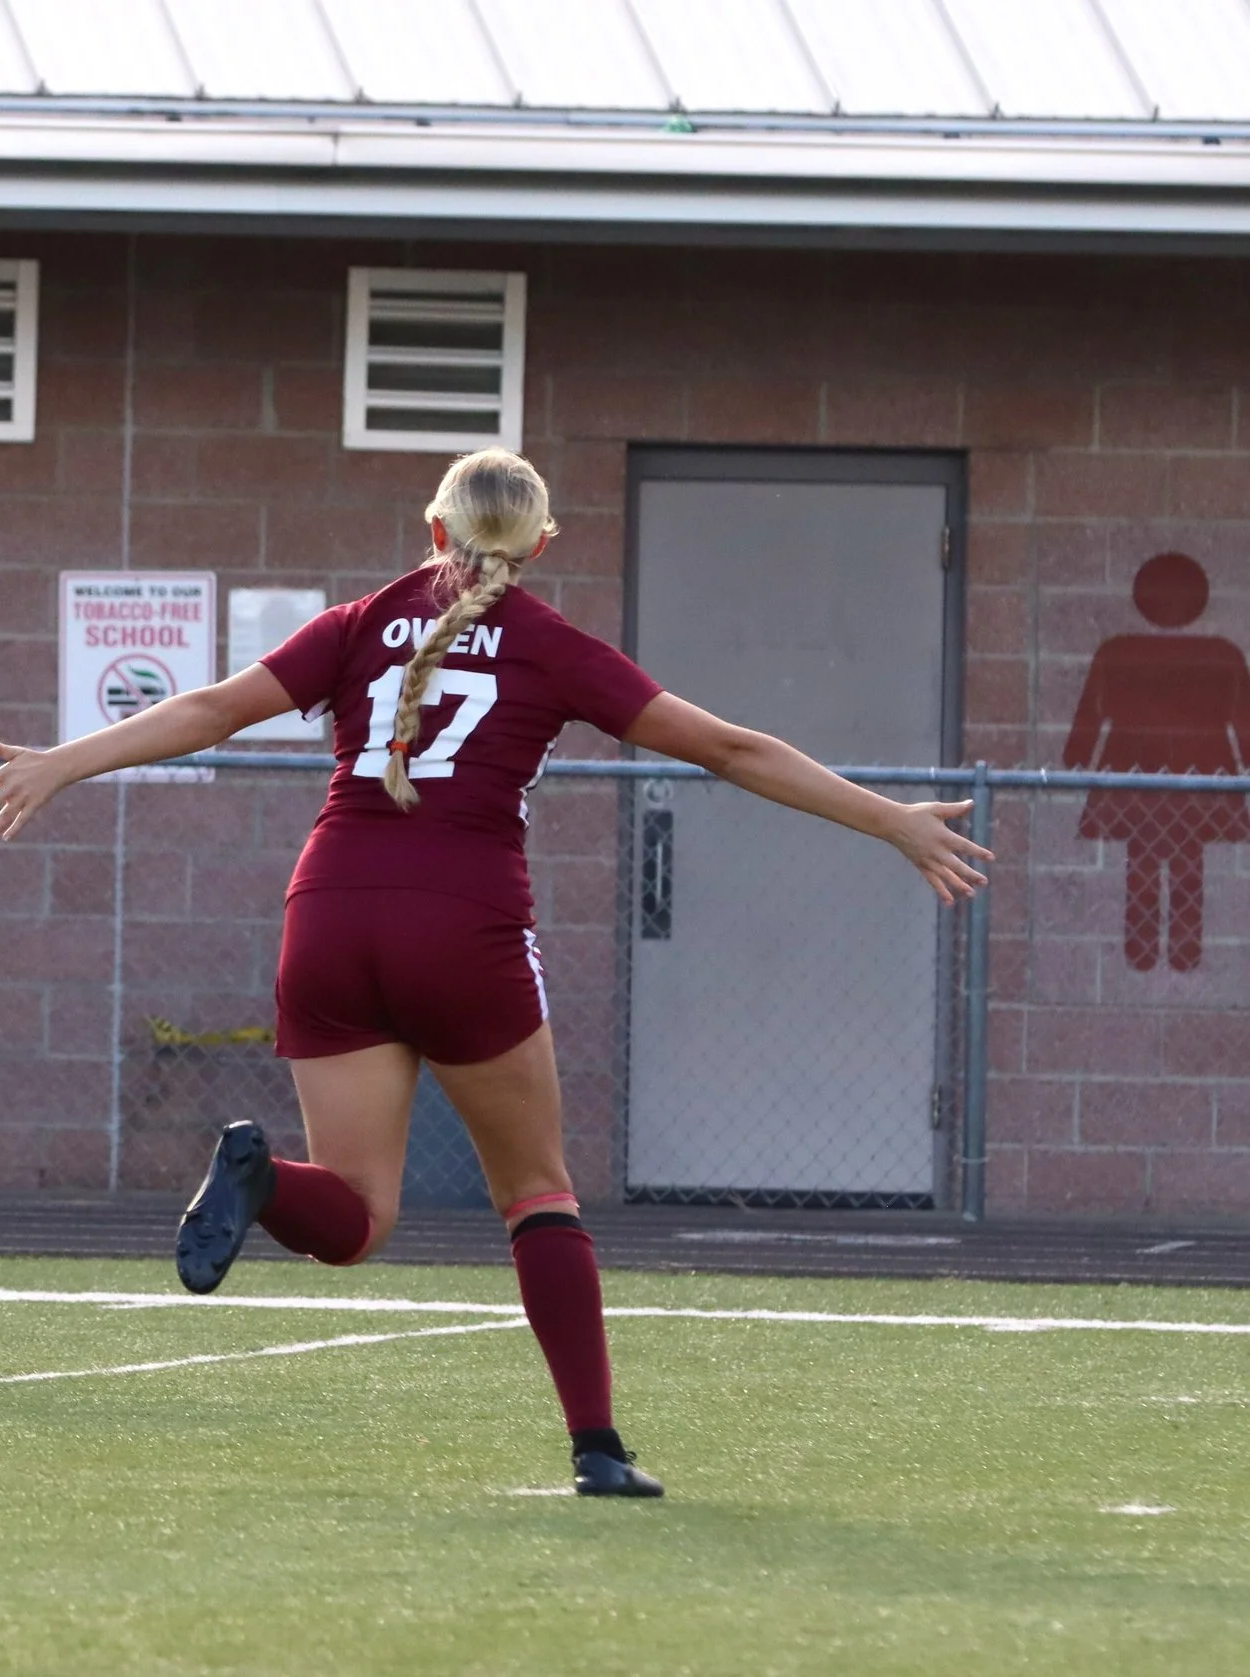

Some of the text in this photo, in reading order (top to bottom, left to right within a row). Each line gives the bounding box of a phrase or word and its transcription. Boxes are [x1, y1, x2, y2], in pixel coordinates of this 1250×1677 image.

[74, 586, 202, 597] WELCOME TO OUR
[73, 601, 202, 621] TOBACCO-FREE
[85, 624, 189, 648] SCHOOL
[352, 665, 498, 779] 17
